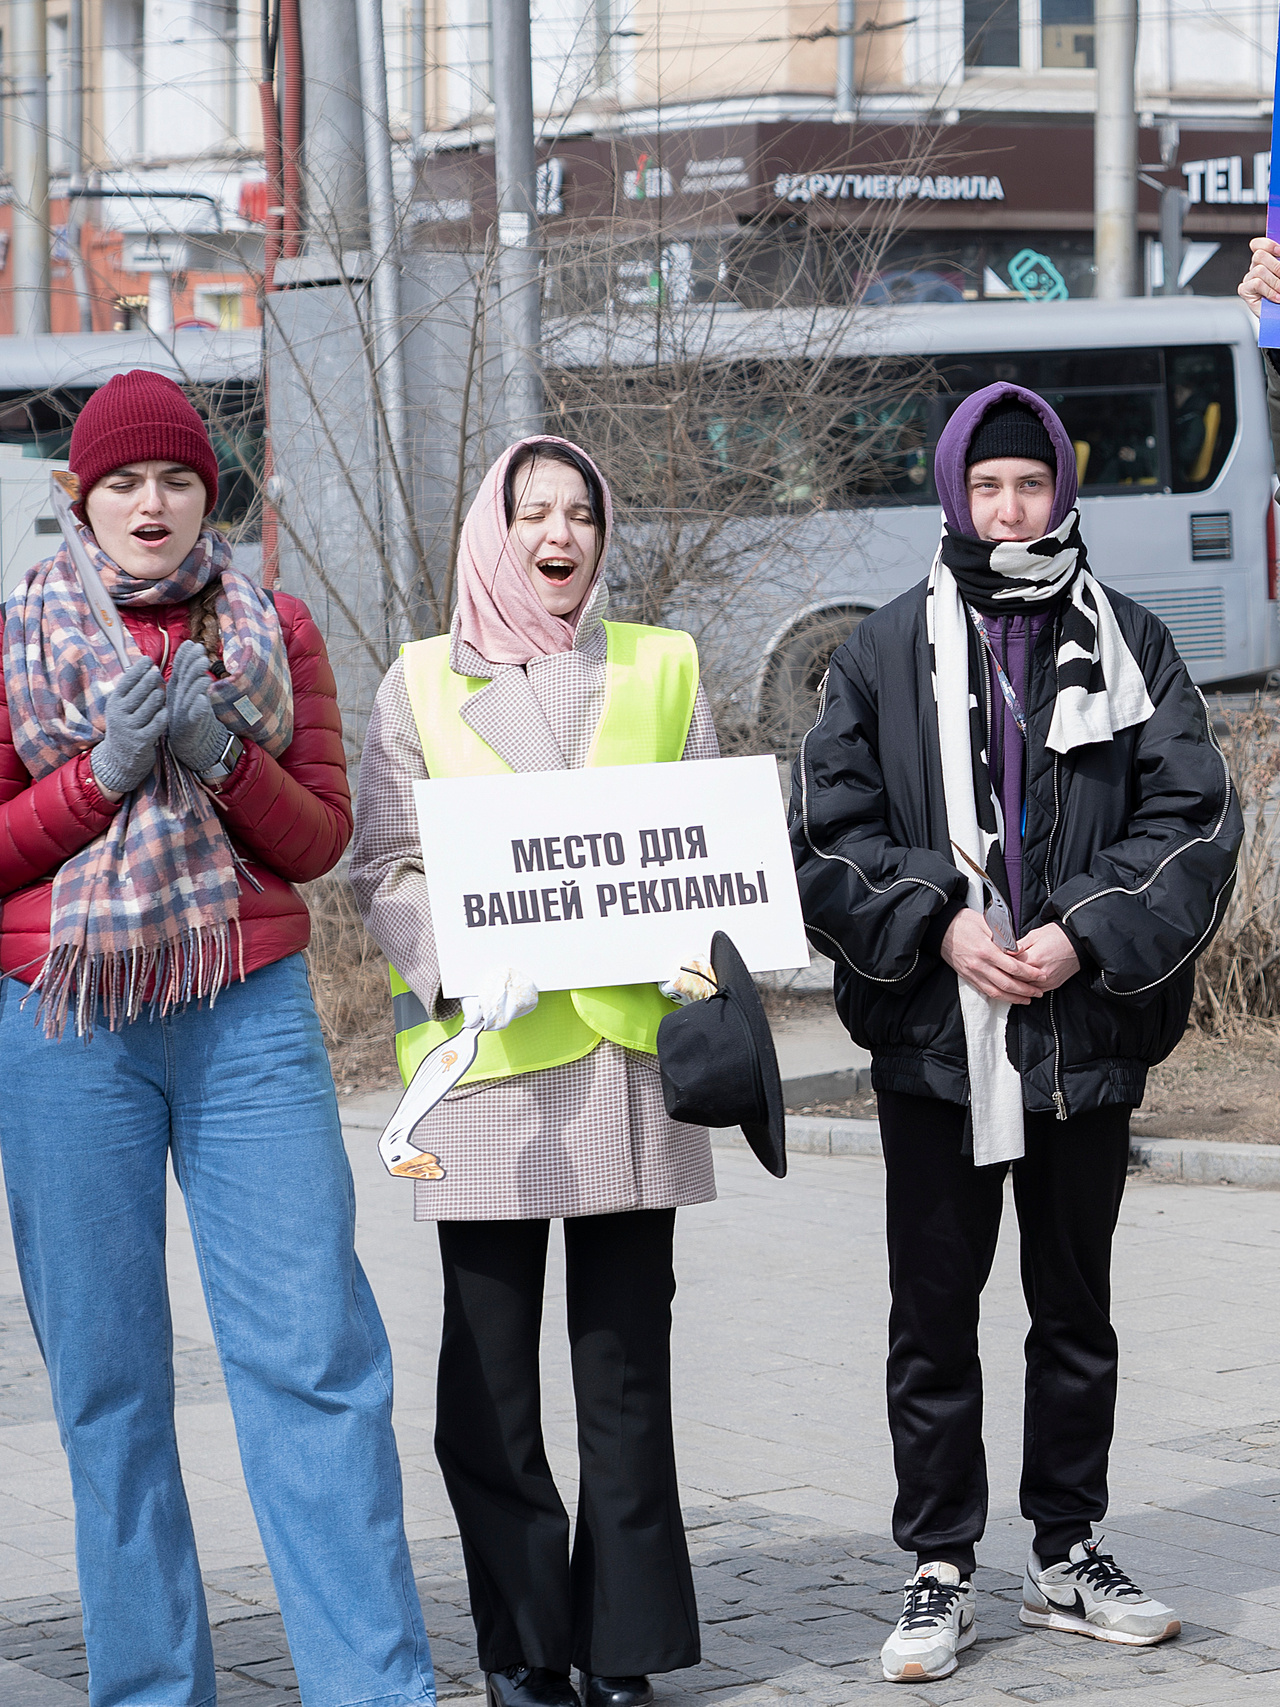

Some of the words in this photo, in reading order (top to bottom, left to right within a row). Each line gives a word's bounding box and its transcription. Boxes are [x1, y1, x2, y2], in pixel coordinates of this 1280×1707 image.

[511, 831, 625, 873] МЕСТО
[639, 825, 708, 868] ДЛЯ
[463, 879, 584, 928] ВАШЕЙ
[596, 870, 769, 917] РЕКЛАМЫ
